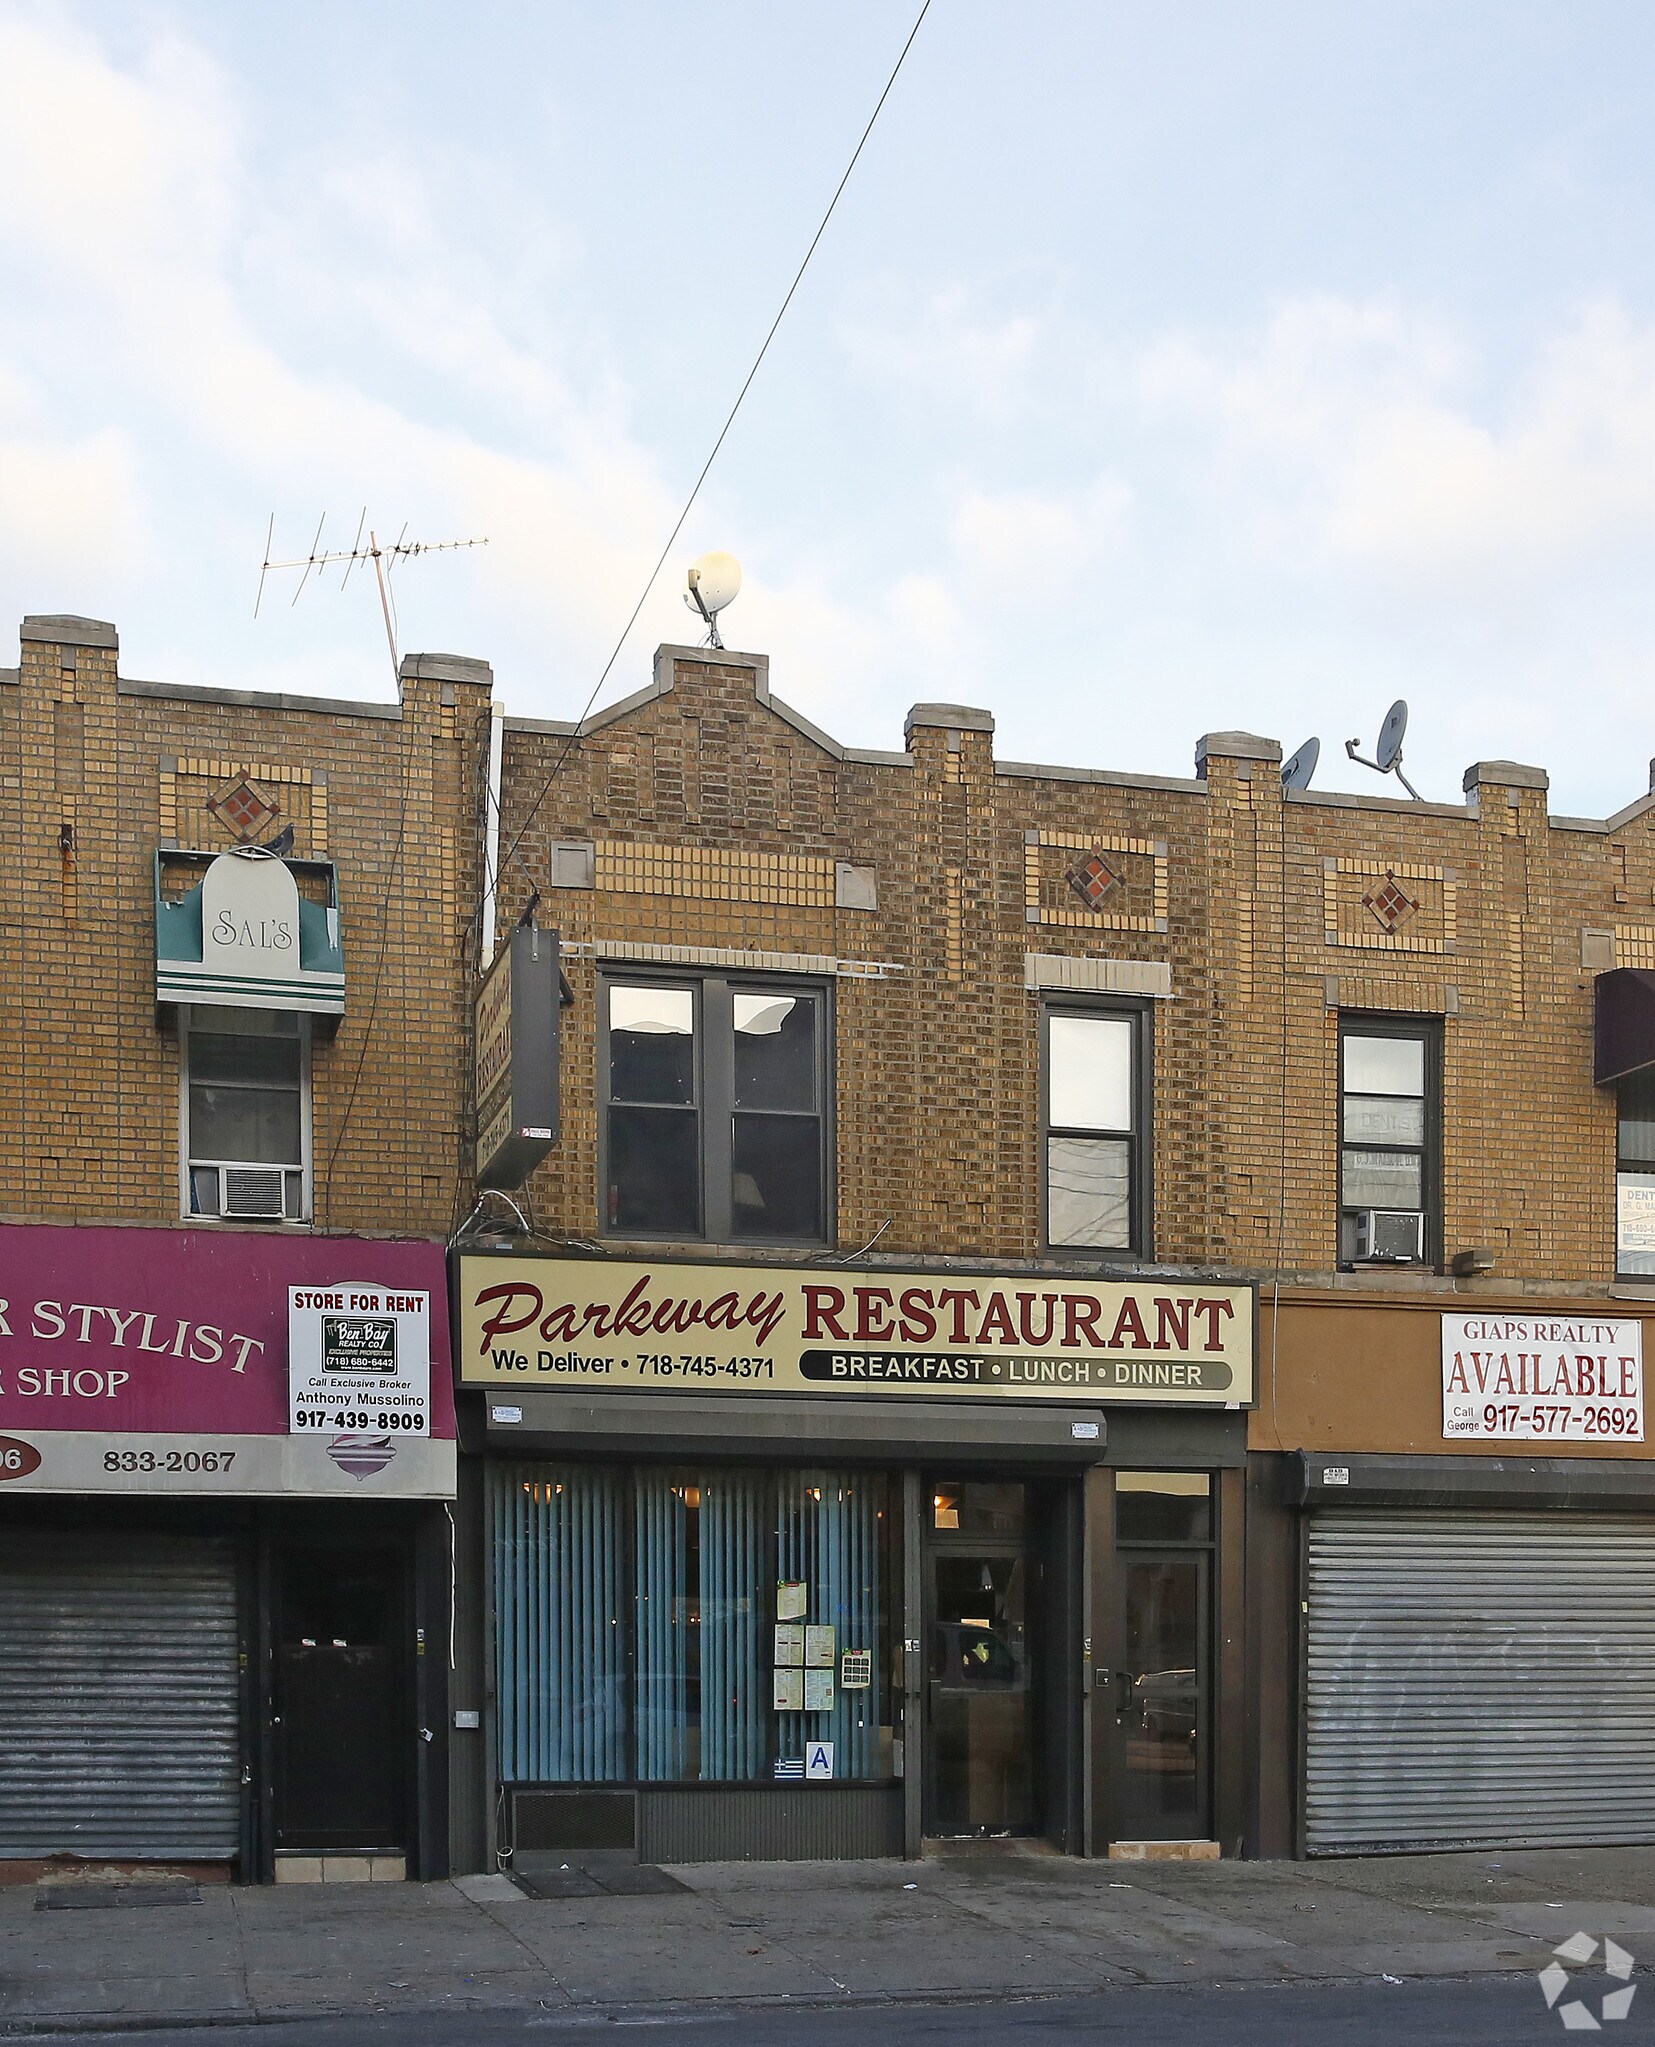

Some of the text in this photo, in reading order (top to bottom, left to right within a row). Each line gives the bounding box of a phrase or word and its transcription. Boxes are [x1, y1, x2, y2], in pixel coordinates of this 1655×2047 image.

[211, 909, 293, 950] SAL'S
[294, 1292, 424, 1313] STORE FOR RENT
[474, 1274, 1236, 1356] Parkway RESTAURANT
[31, 1300, 265, 1375] STYLIST
[1462, 1320, 1620, 1345] GIAPS REALTY
[326, 1357, 394, 1367] (718) 680-6442
[491, 1349, 775, 1378] We Deliver 718-745-4371
[831, 1355, 1203, 1386] BREAKFAST LUNCH DINNER
[17, 1368, 130, 1398] SHOP
[308, 1377, 411, 1389] Call Exclusive Broker
[1446, 1351, 1638, 1398] AVAILABLE
[296, 1391, 424, 1406] Anthony Mussolino
[296, 1411, 424, 1430] 917-439-8909
[1446, 1404, 1640, 1435] George 917-577-2692
[1453, 1406, 1474, 1418] Call
[0, 1449, 22, 1471] 6
[102, 1450, 237, 1473] 833-2067
[810, 1746, 830, 1769] A
